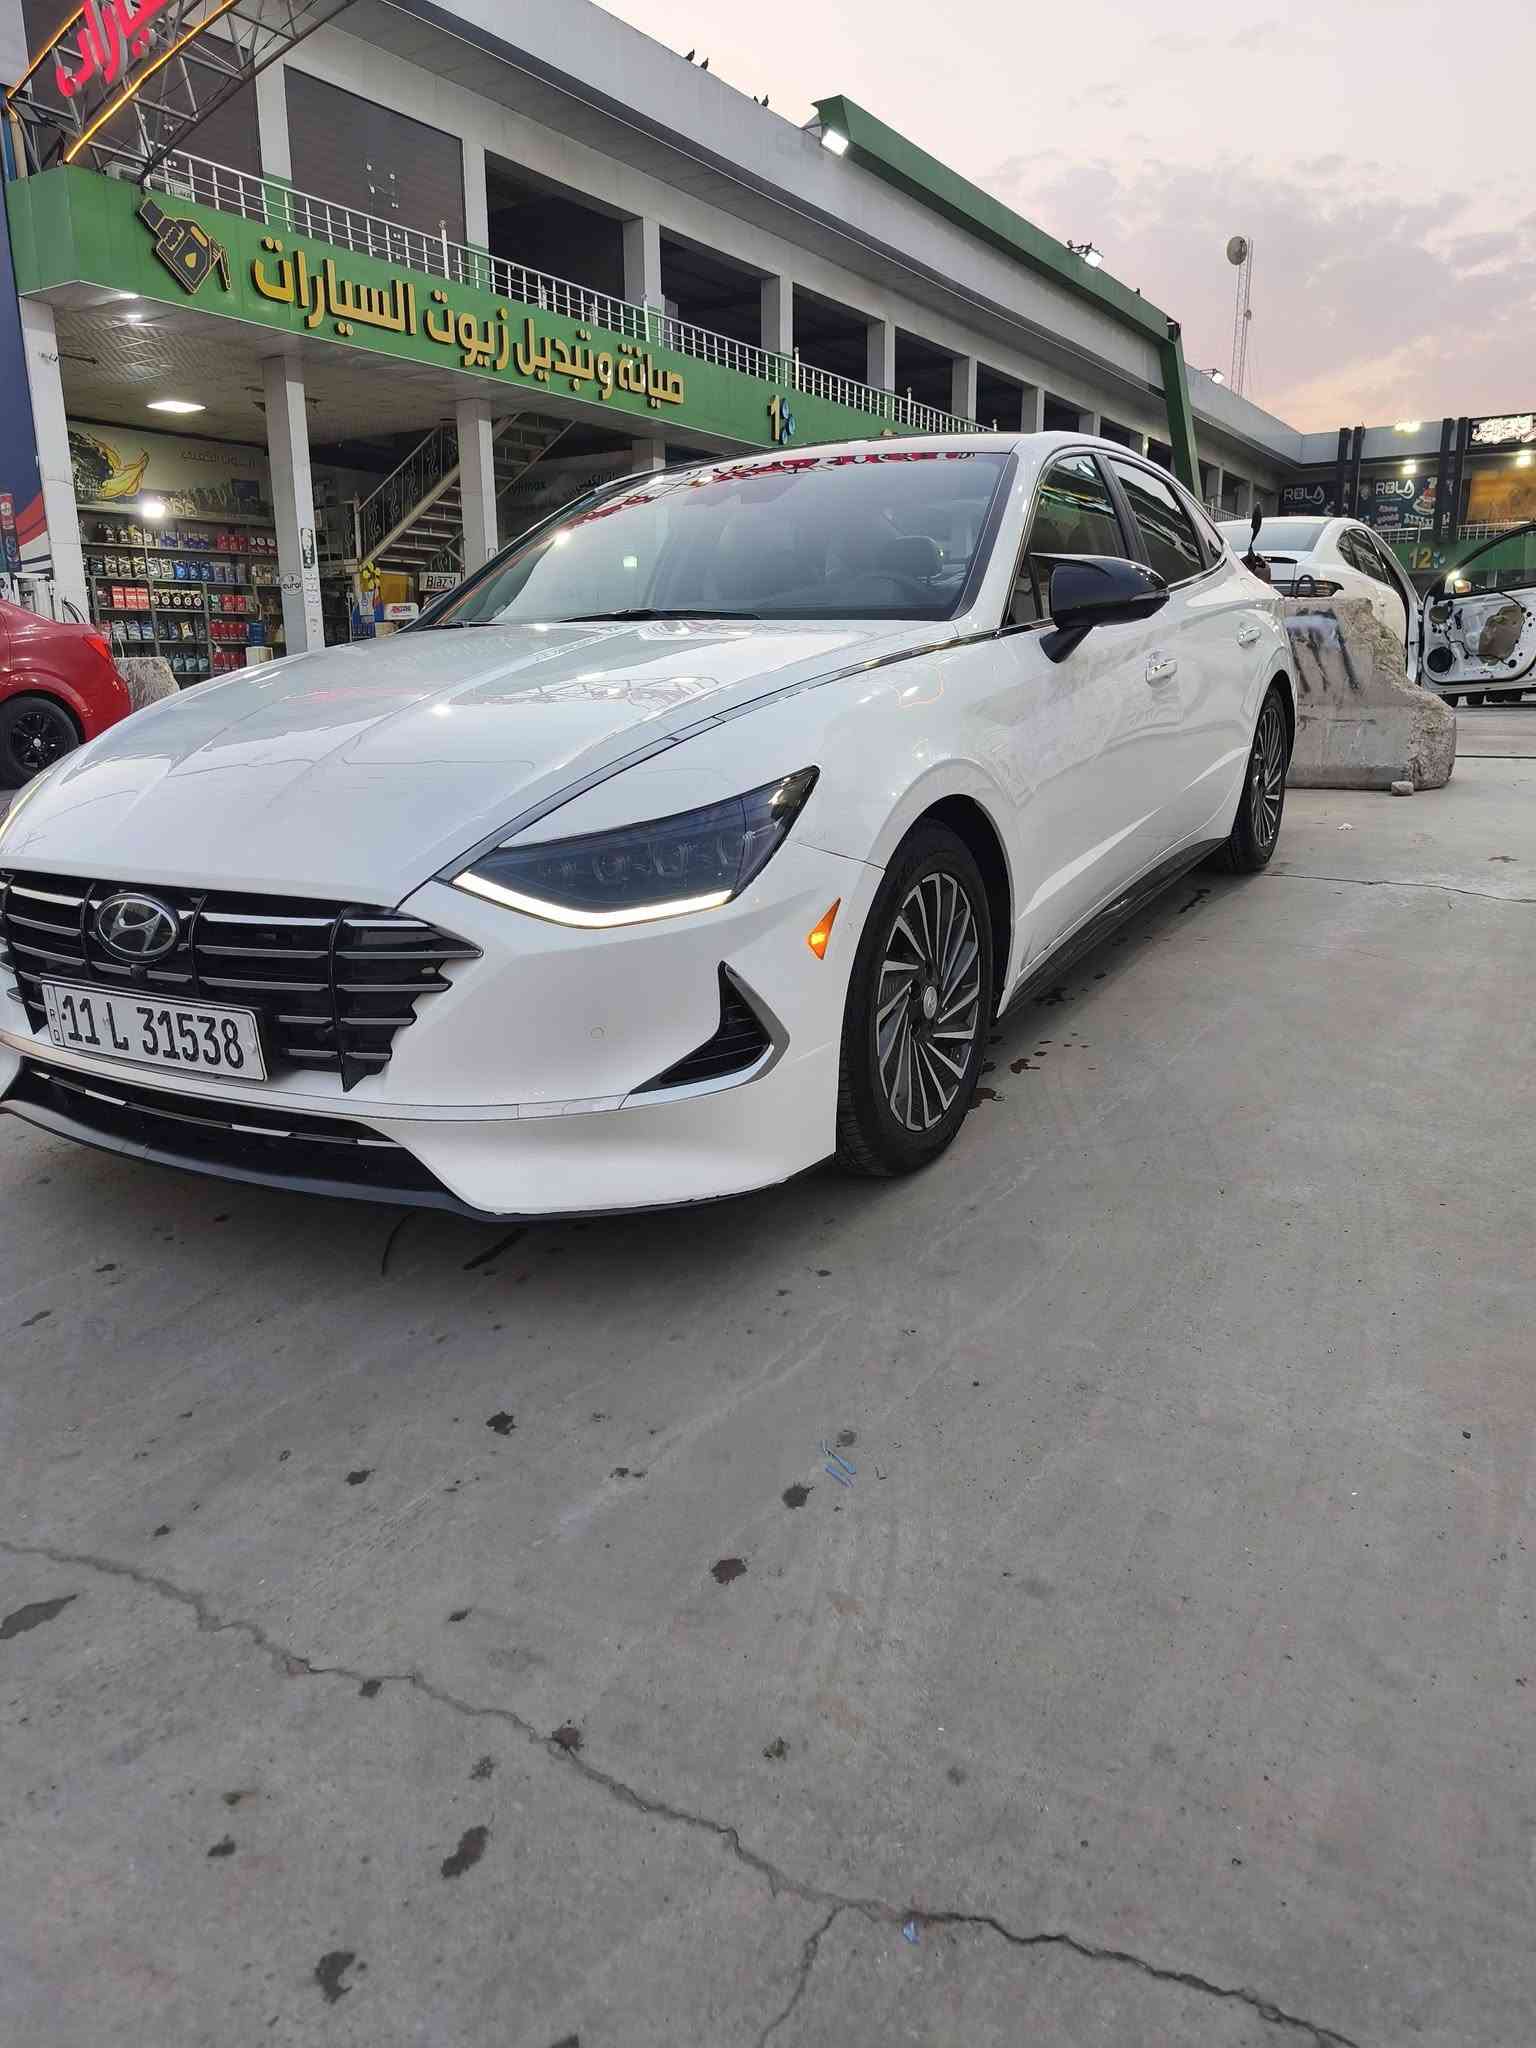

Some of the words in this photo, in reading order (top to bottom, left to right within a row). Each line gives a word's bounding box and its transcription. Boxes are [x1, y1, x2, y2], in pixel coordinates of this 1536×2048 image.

[250, 236, 417, 337] السيارات
[424, 289, 510, 373] زيوت
[512, 317, 614, 401] وتبديل
[617, 343, 684, 409] صيانة
[62, 994, 101, 1045] 11
[105, 1000, 130, 1051] L
[135, 1006, 245, 1070] 31538
